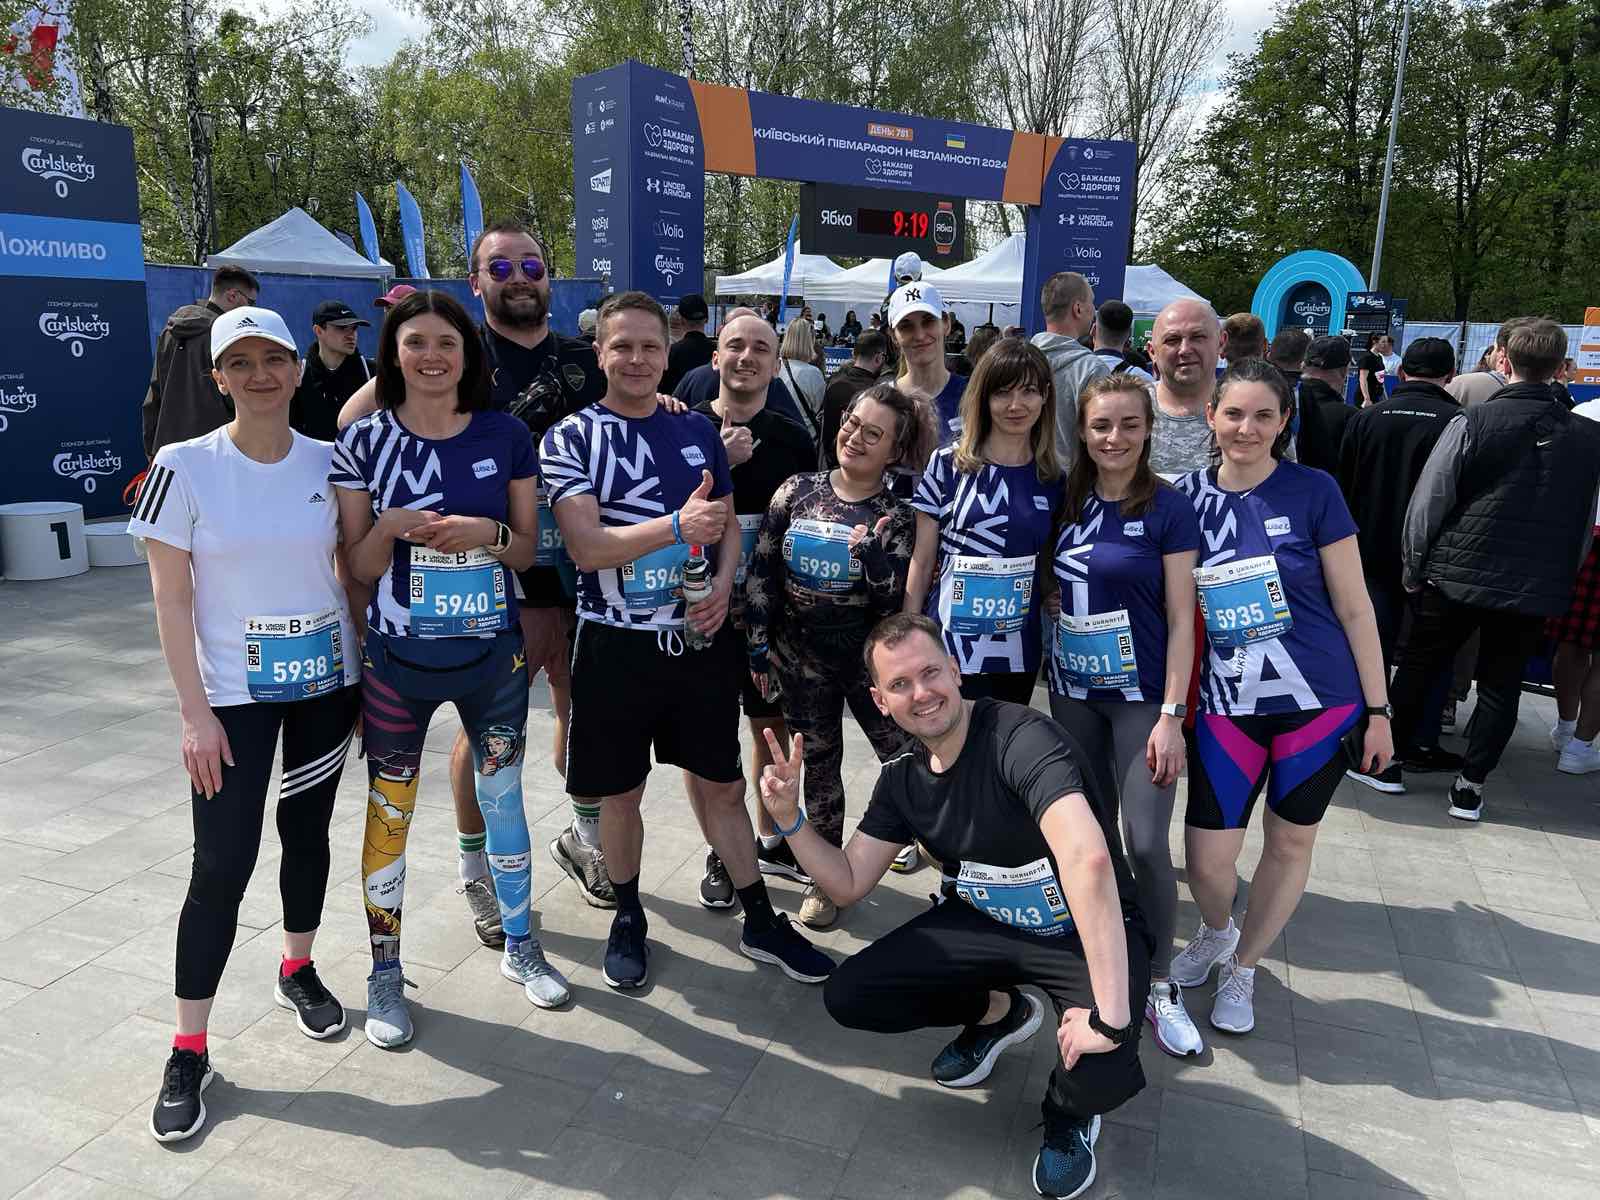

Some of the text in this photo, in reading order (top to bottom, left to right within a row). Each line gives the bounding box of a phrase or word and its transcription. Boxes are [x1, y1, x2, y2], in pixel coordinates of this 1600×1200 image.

[753, 127, 1008, 169] КИЇВСЬКИЙ ПІВМАРАФОН НЕЗЛАМНОСТІ 2024
[22, 147, 95, 183] Carlsberg
[663, 181, 686, 191] UNDER
[663, 188, 691, 199] ARMOUR
[821, 209, 853, 227] Ябко
[894, 210, 929, 240] 9:19
[662, 221, 684, 239] Volia
[0, 231, 107, 260] ожливо
[1075, 247, 1102, 258] Volia
[655, 254, 684, 275] Carlsberg
[1293, 302, 1330, 316] Carlsberg
[38, 312, 110, 342] Carlsberg
[53, 450, 122, 480] Carlsberg
[50, 521, 71, 560] 1
[457, 551, 468, 565] B
[800, 555, 841, 579] 5939
[644, 565, 685, 590] 594
[434, 591, 489, 616] 5940
[972, 596, 1016, 617] 5936
[289, 619, 301, 633] B
[1215, 602, 1265, 630] 5935
[273, 655, 328, 683] 5938
[1068, 652, 1112, 674] 5931
[986, 906, 1043, 926] 5943
